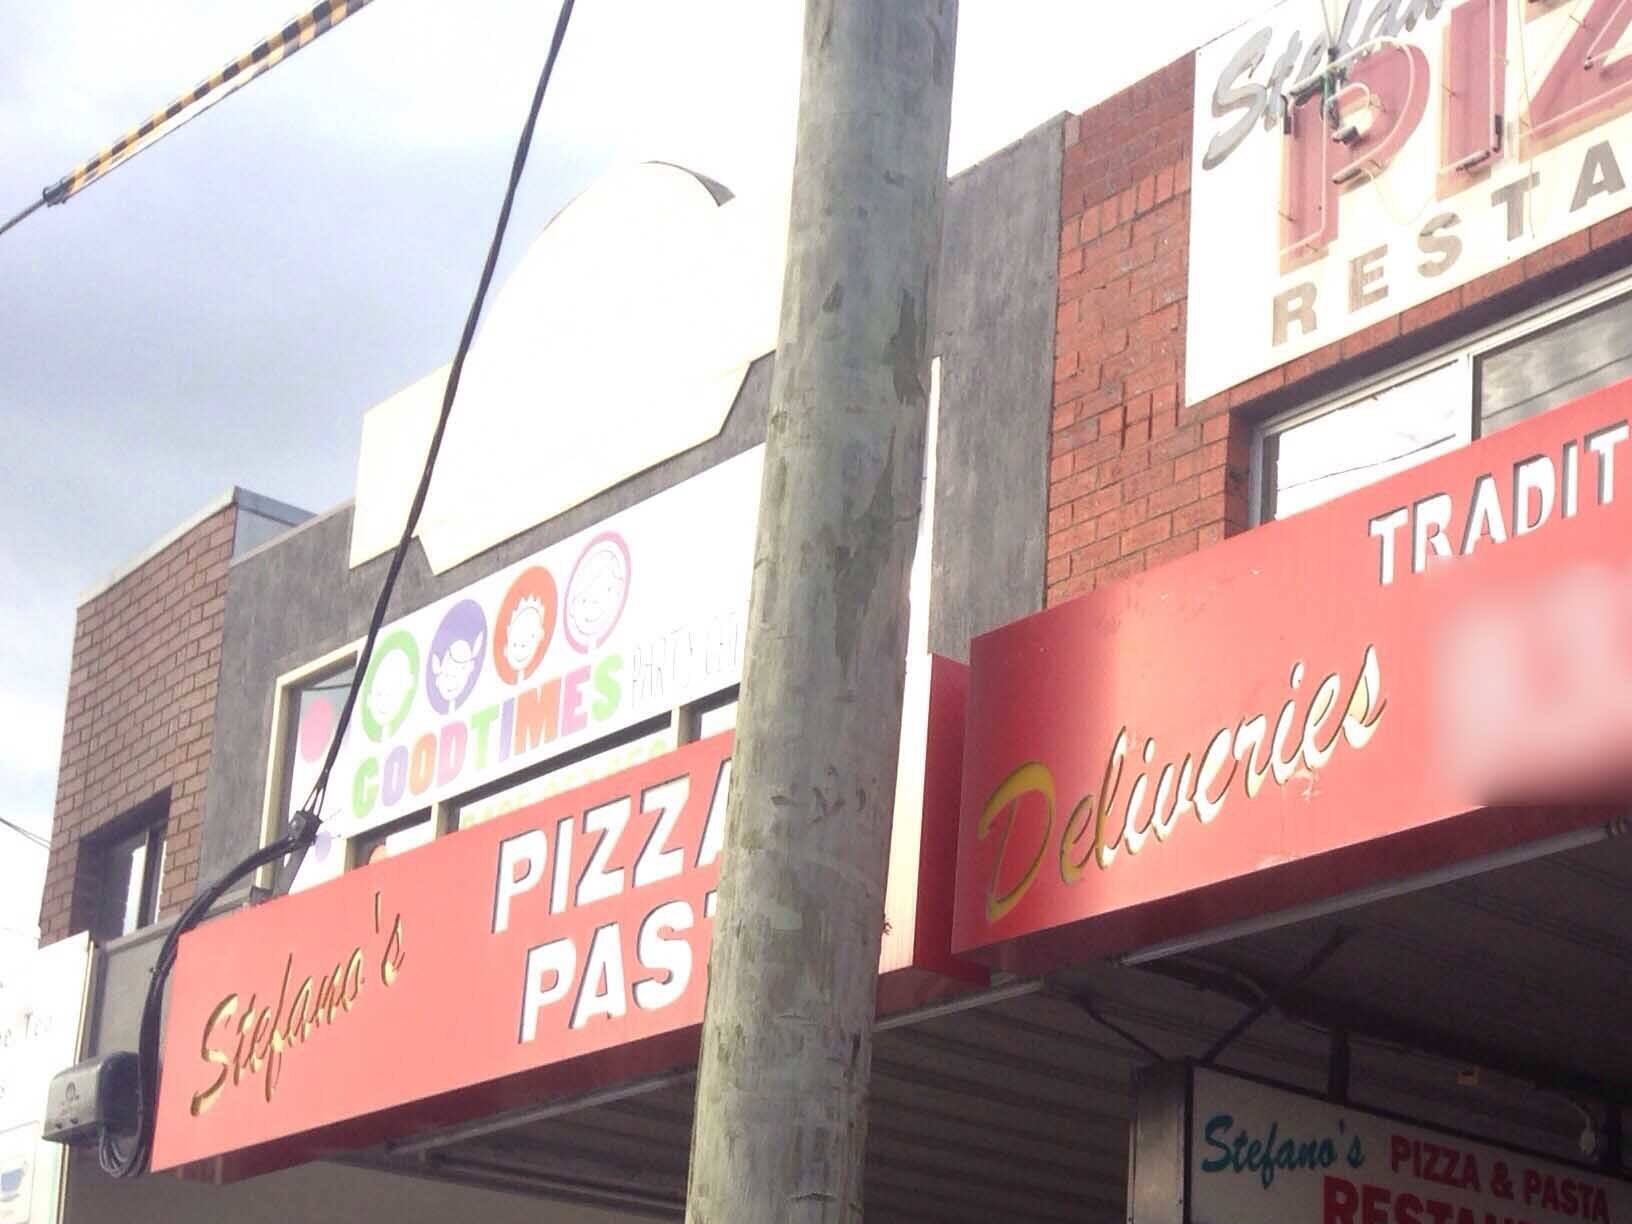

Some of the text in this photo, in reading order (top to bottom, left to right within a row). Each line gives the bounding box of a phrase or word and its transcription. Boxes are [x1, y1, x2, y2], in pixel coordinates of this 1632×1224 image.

[977, 643, 1387, 921] Deliveries
[190, 892, 406, 1117] Stefano's
[518, 889, 717, 1044] PAS
[1201, 1115, 1610, 1224] Stefano's PIZZA & PASTA
